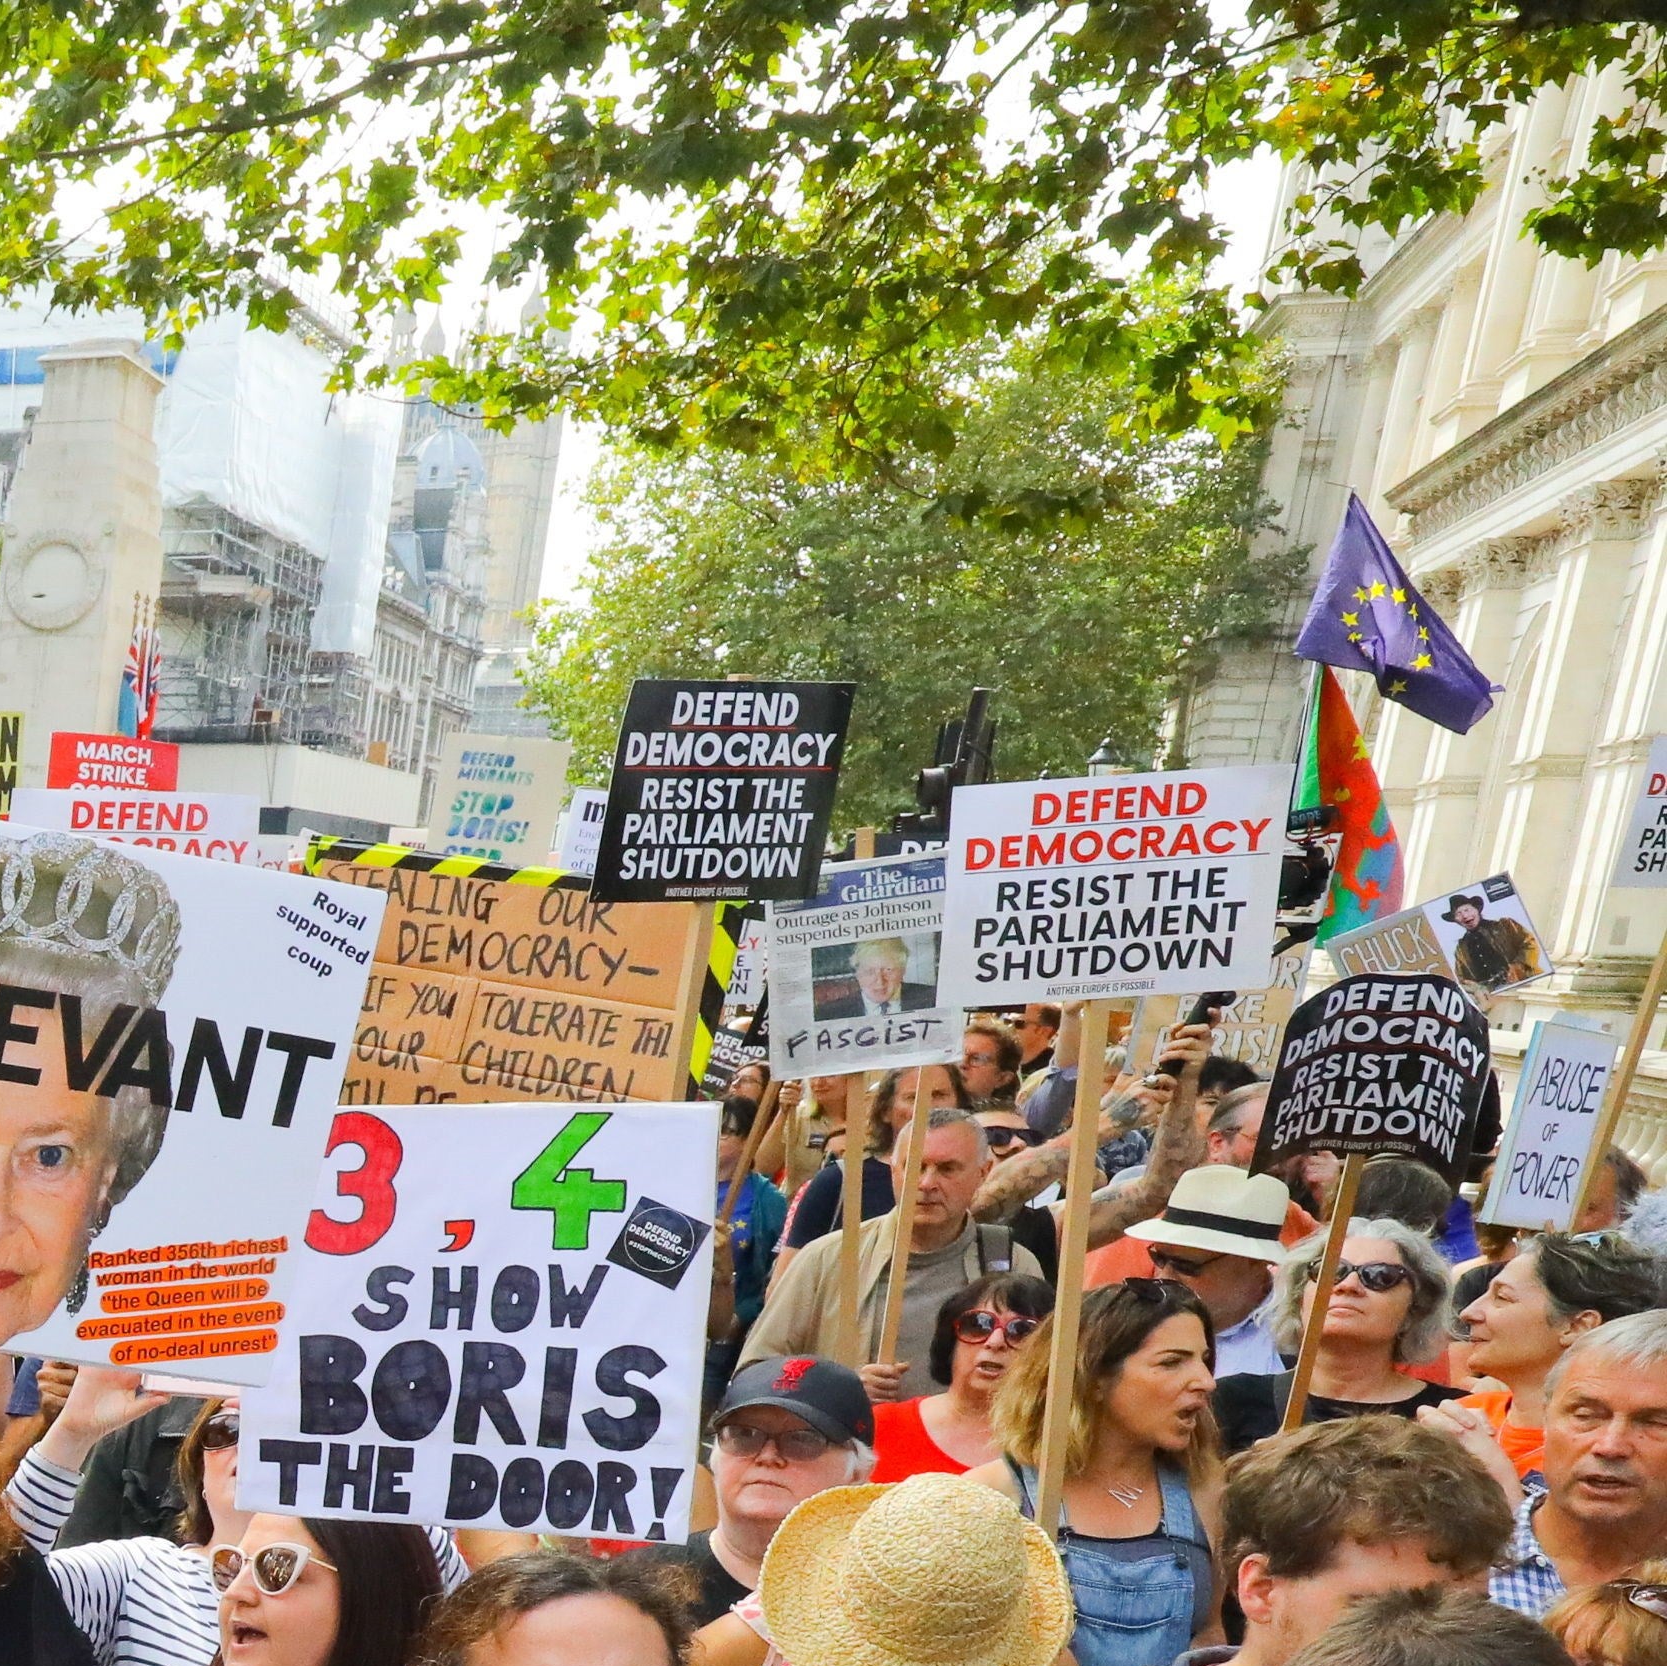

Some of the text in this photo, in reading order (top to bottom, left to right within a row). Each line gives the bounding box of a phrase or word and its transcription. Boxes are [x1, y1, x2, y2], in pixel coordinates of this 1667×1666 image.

[671, 692, 799, 727] DEFEND
[75, 741, 156, 769] MARCH,
[625, 733, 838, 768] DEMOCRACY
[77, 761, 149, 789] STRIKE,
[450, 791, 514, 815] STOP
[639, 779, 806, 810] RESIST THE
[1031, 783, 1207, 826] DEFEND
[71, 801, 208, 832] DEFEND
[446, 820, 530, 843] BORIS!
[621, 813, 813, 848] PARLIAMENT
[966, 818, 1272, 871] DEMOCRACY
[618, 847, 803, 880] SHUTDOWN
[861, 867, 903, 884] The
[840, 876, 946, 903] Guardian
[996, 867, 1227, 912] RESIST THE
[312, 890, 367, 933] Royal
[539, 887, 618, 936] OUR
[776, 899, 932, 931] Outrage as Johnson
[974, 902, 1247, 948] PARLIAMENT
[276, 903, 370, 967] supported
[776, 914, 943, 946] suspends parliament
[1340, 916, 1433, 975] CHUCK
[287, 943, 334, 979] coup
[975, 937, 1233, 983] SHUTDOWN
[361, 975, 622, 1048] IF YOU TOLERATE
[1323, 982, 1465, 1024] DEFEND
[1283, 1014, 1485, 1078] DEMOCRACY
[462, 1041, 634, 1103] CHILDREN
[1292, 1051, 1464, 1104] RESIST THE
[1535, 1059, 1605, 1116] ABUSE
[1275, 1079, 1465, 1136] PARLIAMENT
[1271, 1106, 1456, 1163] SHUTDOWN
[1542, 1121, 1560, 1141] OF
[511, 1111, 627, 1251] 4
[1508, 1154, 1581, 1204] POWER
[628, 1224, 690, 1257] DEMOCRACY
[645, 1221, 681, 1244] DEFEND
[91, 1236, 288, 1269] Ranked 356th richest
[97, 1258, 275, 1286] woman in the world
[146, 1291, 205, 1307] Queen
[211, 1282, 240, 1300] will
[246, 1281, 267, 1298] be
[351, 1264, 610, 1333] SHOW
[77, 1305, 284, 1338] evacuated in the event
[115, 1334, 278, 1361] of no-deal unrest"
[299, 1334, 668, 1452] BORIS
[259, 1439, 684, 1542] THE DOOR!
